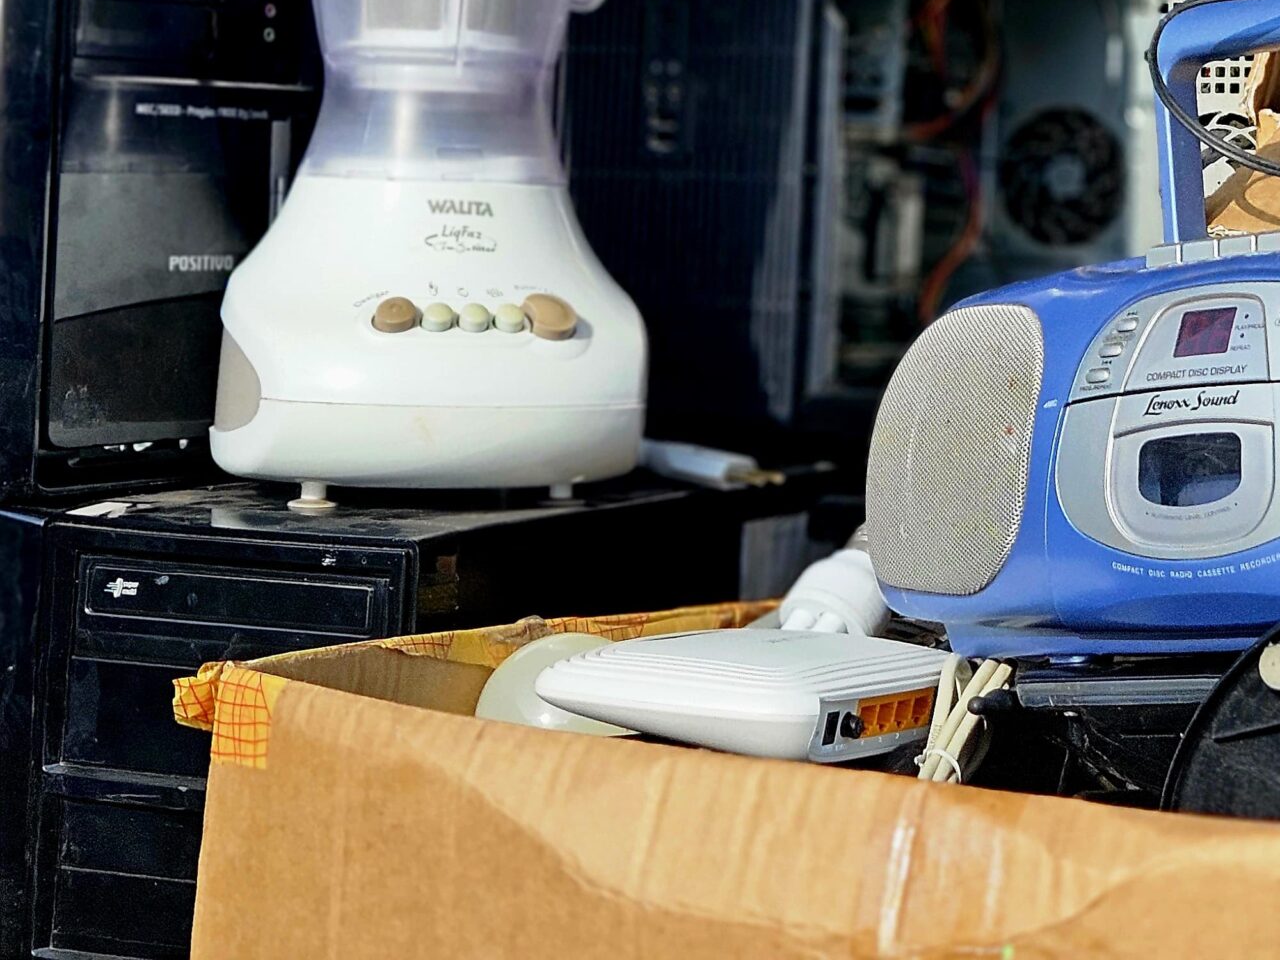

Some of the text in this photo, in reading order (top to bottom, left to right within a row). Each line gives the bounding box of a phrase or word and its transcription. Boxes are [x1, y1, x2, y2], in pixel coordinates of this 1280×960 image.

[427, 199, 494, 217] WALITA
[168, 255, 234, 271] POSITIVO
[1146, 364, 1248, 382] COMPACT DISC DISPLAY
[1190, 390, 1240, 411] Sound
[1111, 561, 1145, 576] COMPACT
[1148, 569, 1166, 578] DISC
[1169, 570, 1193, 579] RADIO
[1197, 566, 1236, 578] CASSETTE
